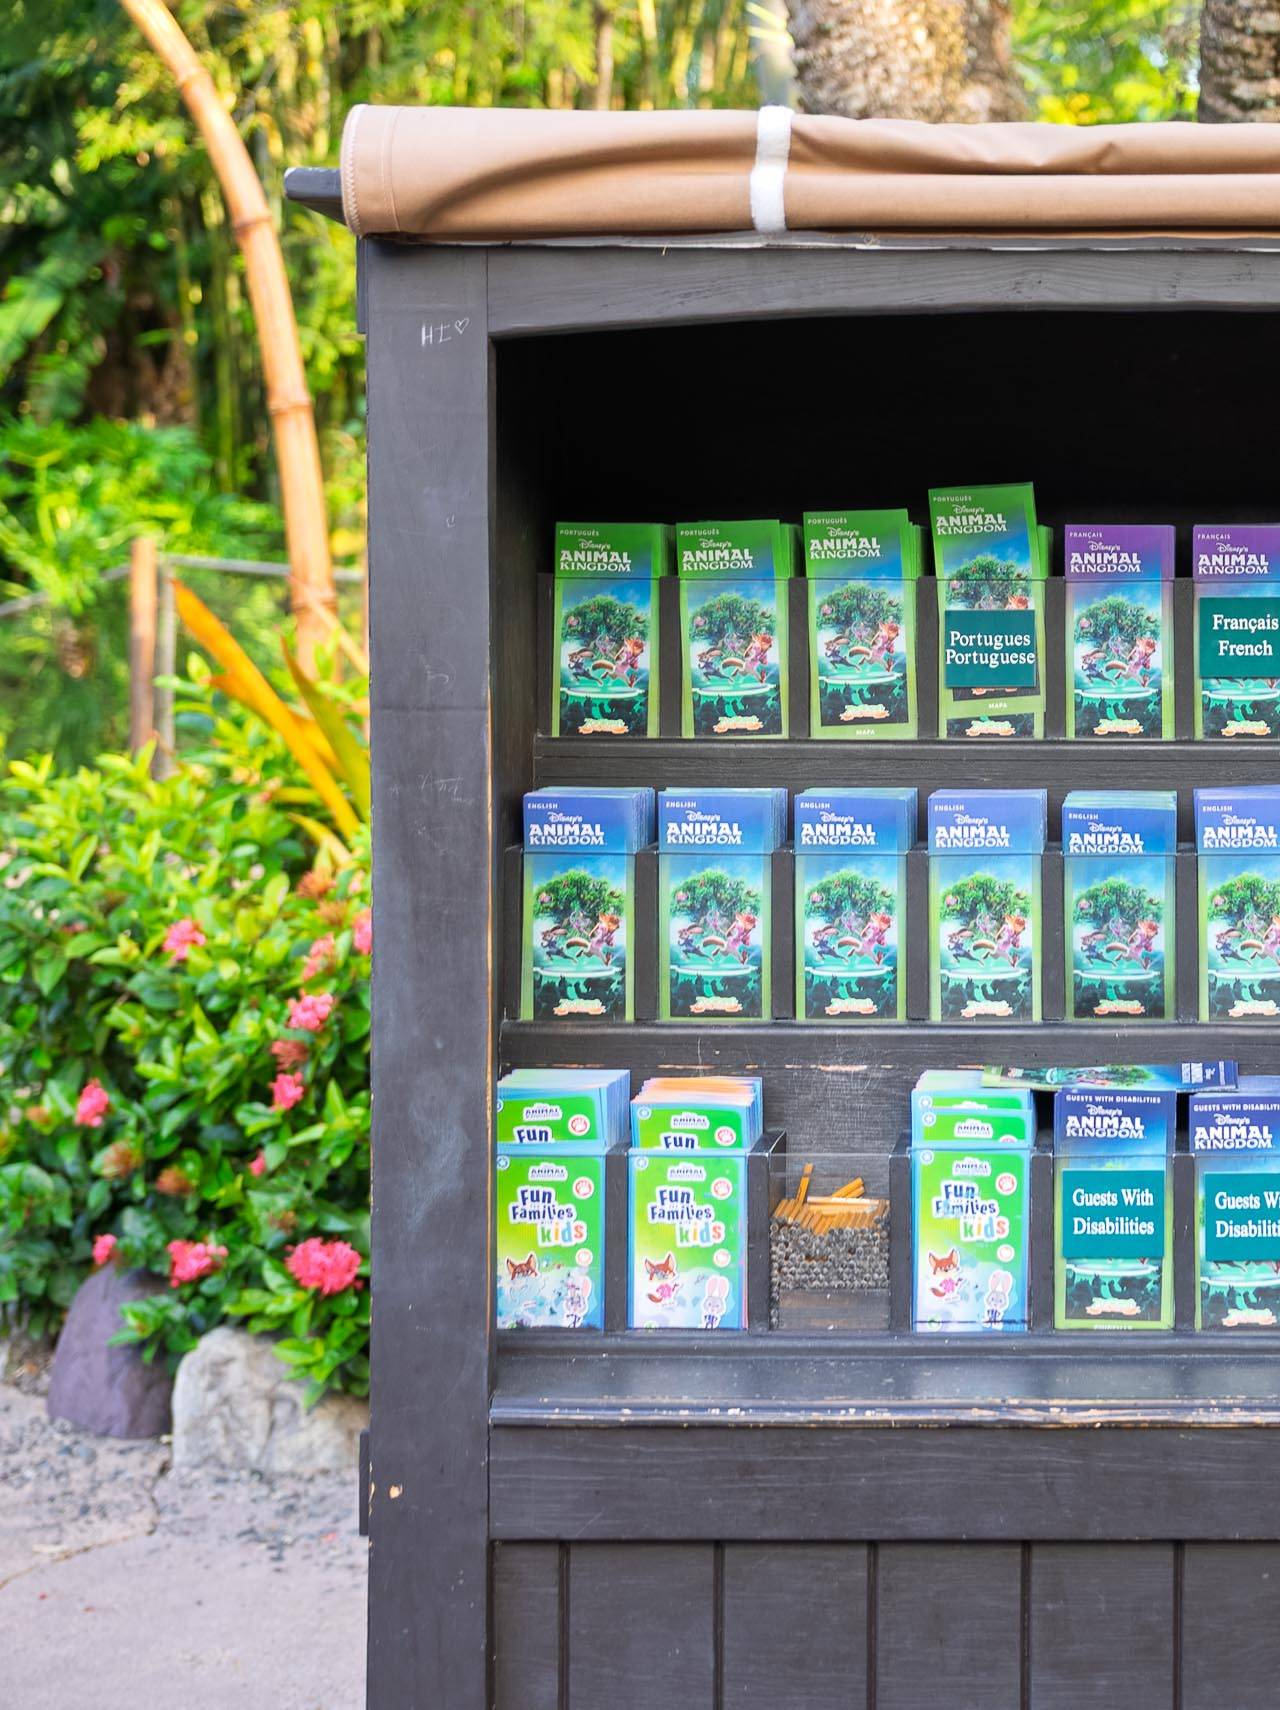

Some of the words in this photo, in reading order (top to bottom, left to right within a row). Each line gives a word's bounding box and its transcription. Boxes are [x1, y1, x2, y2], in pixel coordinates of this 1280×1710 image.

[952, 504, 985, 515] Disney's
[936, 513, 1007, 526] ANIMAL
[826, 526, 860, 538] Disney's
[936, 524, 1008, 536] KINGDOM
[578, 539, 611, 552] Disney's
[699, 538, 732, 550] Disney's
[809, 537, 881, 550] ANIMAL
[1088, 541, 1121, 553] Disney's
[1216, 543, 1249, 555] Disney's
[559, 550, 632, 563] ANIMAL
[682, 549, 753, 562] ANIMAL
[809, 548, 882, 559] KINGDOM
[1070, 552, 1141, 564] ANIMAL
[1199, 554, 1269, 566] ANIMAL
[559, 561, 632, 572] KINGDOM
[682, 560, 754, 571] KINGDOM
[1070, 563, 1142, 573] KINGDOM
[1199, 565, 1269, 574] KINGDOM
[1212, 614, 1279, 633] Français
[950, 631, 1031, 650] Portugues
[1218, 640, 1273, 656] French
[946, 649, 1036, 669] Portuguese
[934, 804, 965, 812] ENGLISH
[547, 812, 583, 824] Disney's
[685, 810, 721, 823] Disney's
[820, 811, 855, 824] Disney's
[953, 814, 989, 826] Disney's
[1221, 814, 1257, 827] Disney's
[529, 823, 604, 836] ANIMAL
[667, 822, 742, 835] ANIMAL
[801, 824, 876, 836] ANIMAL
[935, 826, 1010, 838] ANIMAL
[1088, 822, 1122, 834] Disney's
[1203, 826, 1278, 838] ANIMAL
[529, 835, 605, 845] KINGDOM
[667, 834, 742, 845] KINGDOM
[801, 835, 877, 845] KINGDOM
[935, 838, 1010, 848] KINGDOM
[1069, 833, 1144, 846] ANIMAL
[1203, 837, 1279, 848] KINGDOM
[1069, 845, 1144, 854] KINGDOM
[1066, 1095, 1092, 1103] GUESTS
[1095, 1095, 1114, 1103] WITH
[1116, 1096, 1161, 1104] DISABILITIES
[1087, 1104, 1122, 1117] Disney's
[1193, 1104, 1219, 1112] GUESTS
[1066, 1116, 1144, 1129] ANIMAL
[1213, 1113, 1250, 1126] Disney's
[517, 1127, 549, 1142] Fun
[1066, 1128, 1145, 1139] KINGDOM
[1194, 1125, 1273, 1139] ANIMAL
[663, 1135, 695, 1149] Fun
[1194, 1138, 1274, 1149] KINGDOM
[521, 1189, 552, 1204] Fun
[659, 1189, 691, 1204] Fun
[944, 1183, 976, 1199] Fun
[1073, 1188, 1118, 1206] Guests
[1121, 1189, 1154, 1206] With
[1215, 1191, 1260, 1209] Guests
[512, 1204, 573, 1220] Families
[650, 1204, 712, 1220] Families
[935, 1200, 996, 1216] Families
[540, 1222, 584, 1243] kids
[678, 1222, 722, 1243] kids
[963, 1218, 1006, 1239] kids
[1073, 1217, 1154, 1235] Disabilities
